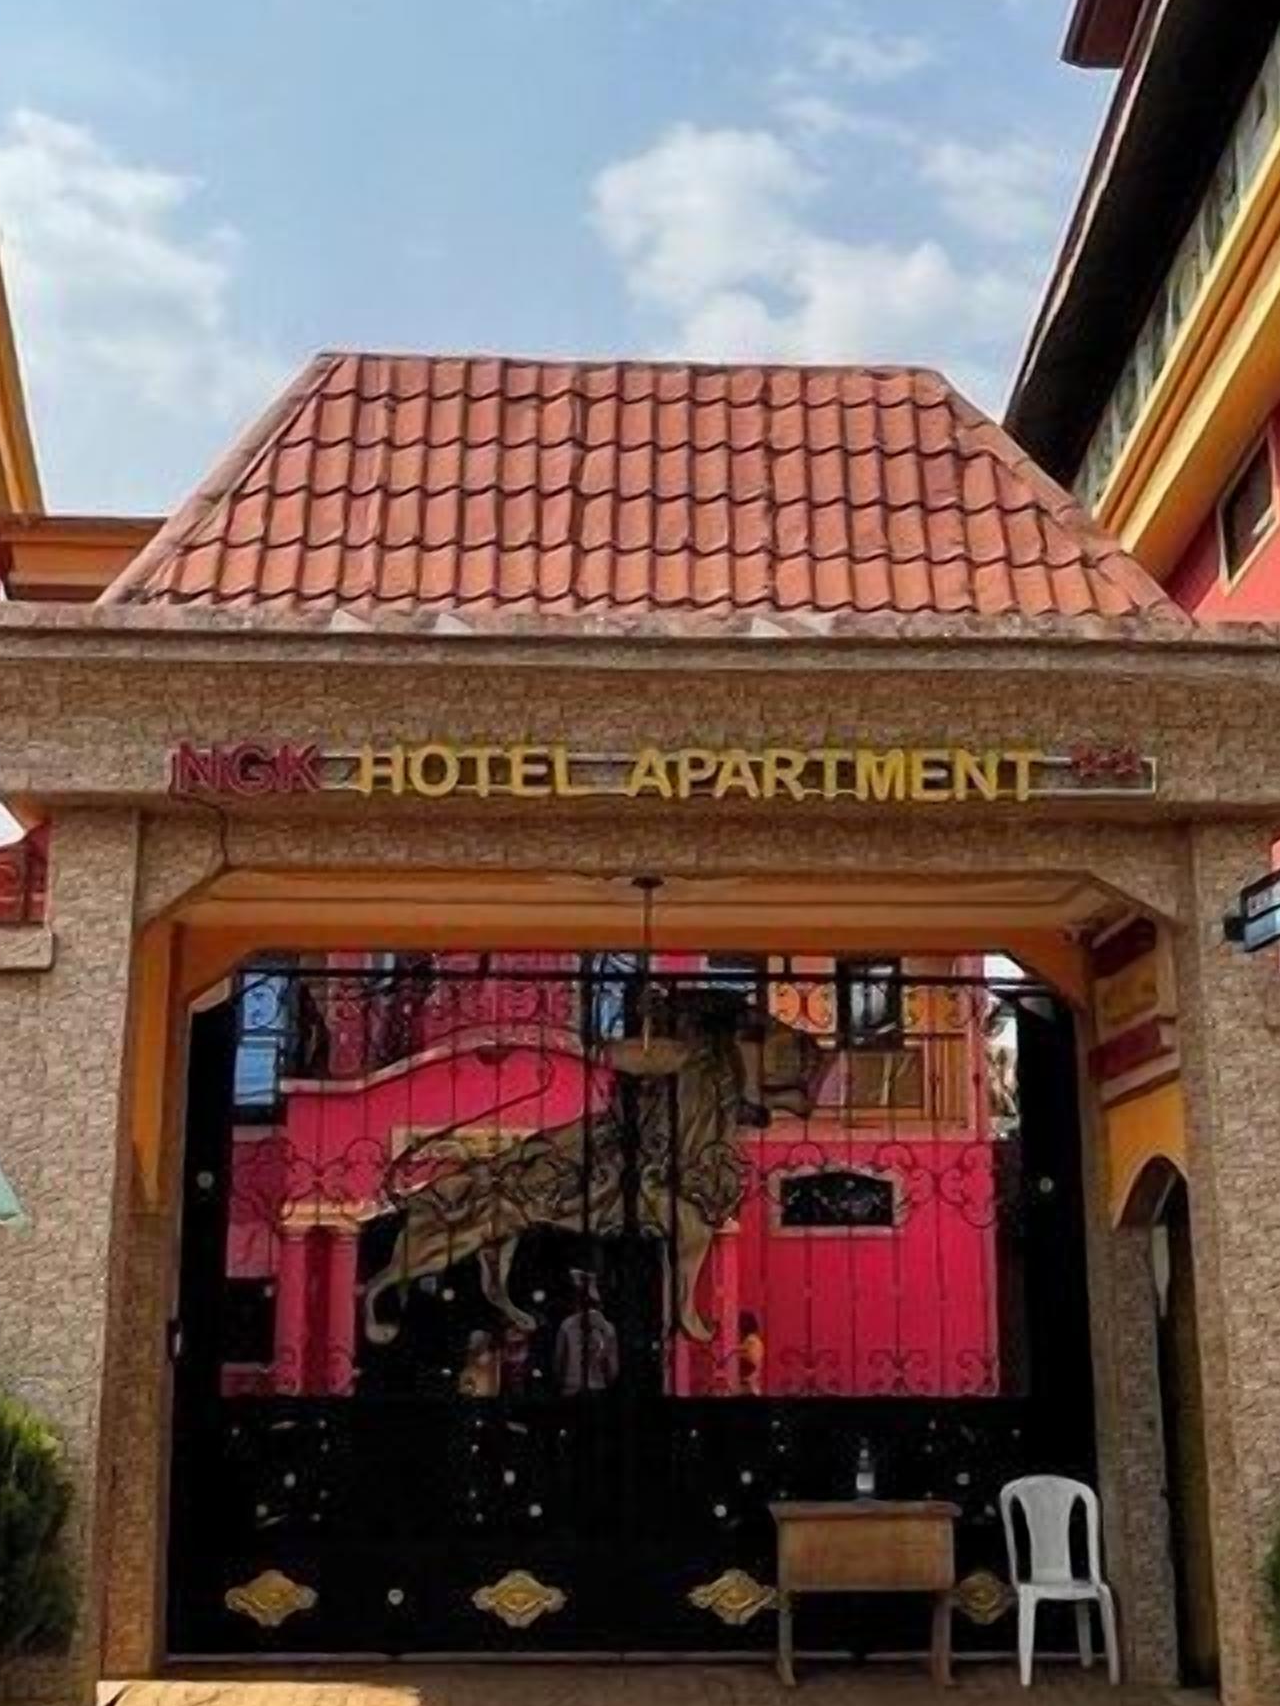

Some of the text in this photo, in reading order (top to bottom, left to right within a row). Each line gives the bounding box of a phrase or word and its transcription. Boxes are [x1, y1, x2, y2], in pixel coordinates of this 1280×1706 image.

[173, 742, 1045, 801] NGK HOTEL APARTMENT
